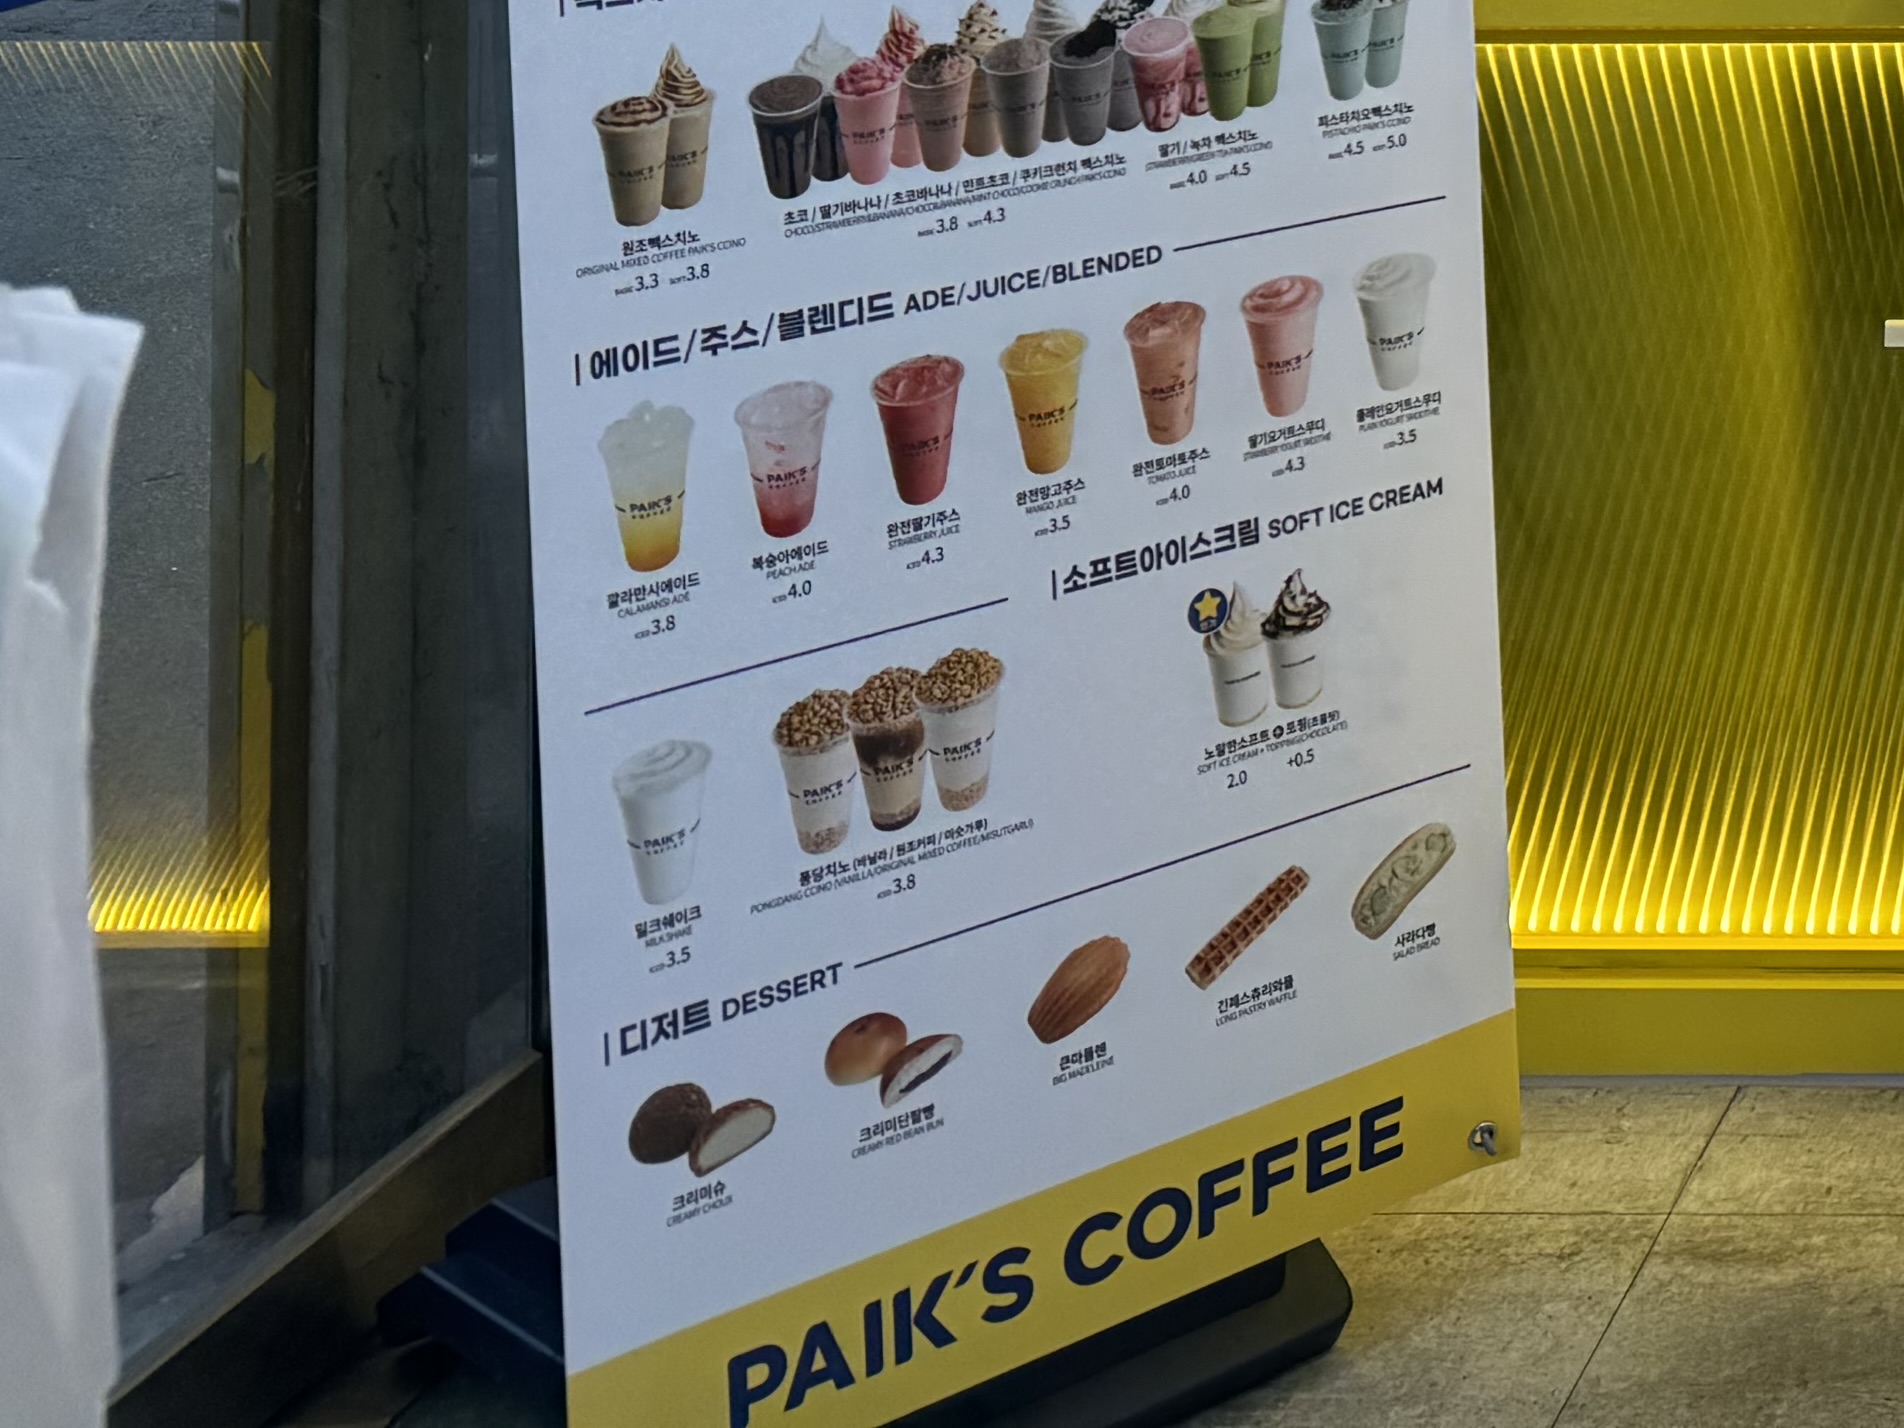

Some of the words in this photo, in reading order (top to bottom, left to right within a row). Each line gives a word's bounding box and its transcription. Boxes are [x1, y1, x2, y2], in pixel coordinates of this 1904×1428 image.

[1344, 140, 1364, 155] 4.5
[1387, 133, 1407, 149] 5.0
[1187, 170, 1207, 185] 4.0
[1230, 162, 1250, 177] 4.5
[784, 210, 809, 226] 초코
[936, 217, 958, 233] 3.8
[983, 209, 1006, 225] 4.3
[635, 274, 659, 292] 3.3
[687, 264, 710, 282] 3.8
[590, 291, 894, 379] 에이드/주스/블렌디드
[904, 245, 1163, 315] ADE/JUICE/BLENDED
[1396, 430, 1417, 446] 3.5
[1284, 458, 1305, 473] 4.3
[1169, 485, 1191, 502] 4.0
[1049, 516, 1071, 533] 3.5
[1063, 517, 1260, 595] 소프트아이스크림
[1268, 507, 1326, 538] SOFT
[1329, 498, 1364, 523] ICE
[1369, 478, 1444, 512] CREAM
[921, 547, 944, 565] 4.3
[788, 581, 812, 598] 4.0
[650, 616, 676, 636] 3.8
[1227, 771, 1248, 789] 2.0
[1287, 749, 1315, 769] +0.5
[892, 875, 916, 894] 3.8
[665, 947, 691, 968] 3.5
[620, 999, 711, 1056] 디저트
[722, 963, 843, 1021] DESSERT
[672, 1181, 726, 1211] 크리미슈
[727, 1246, 1035, 1428] PAIK'S
[1064, 1095, 1404, 1286] COFFEE
